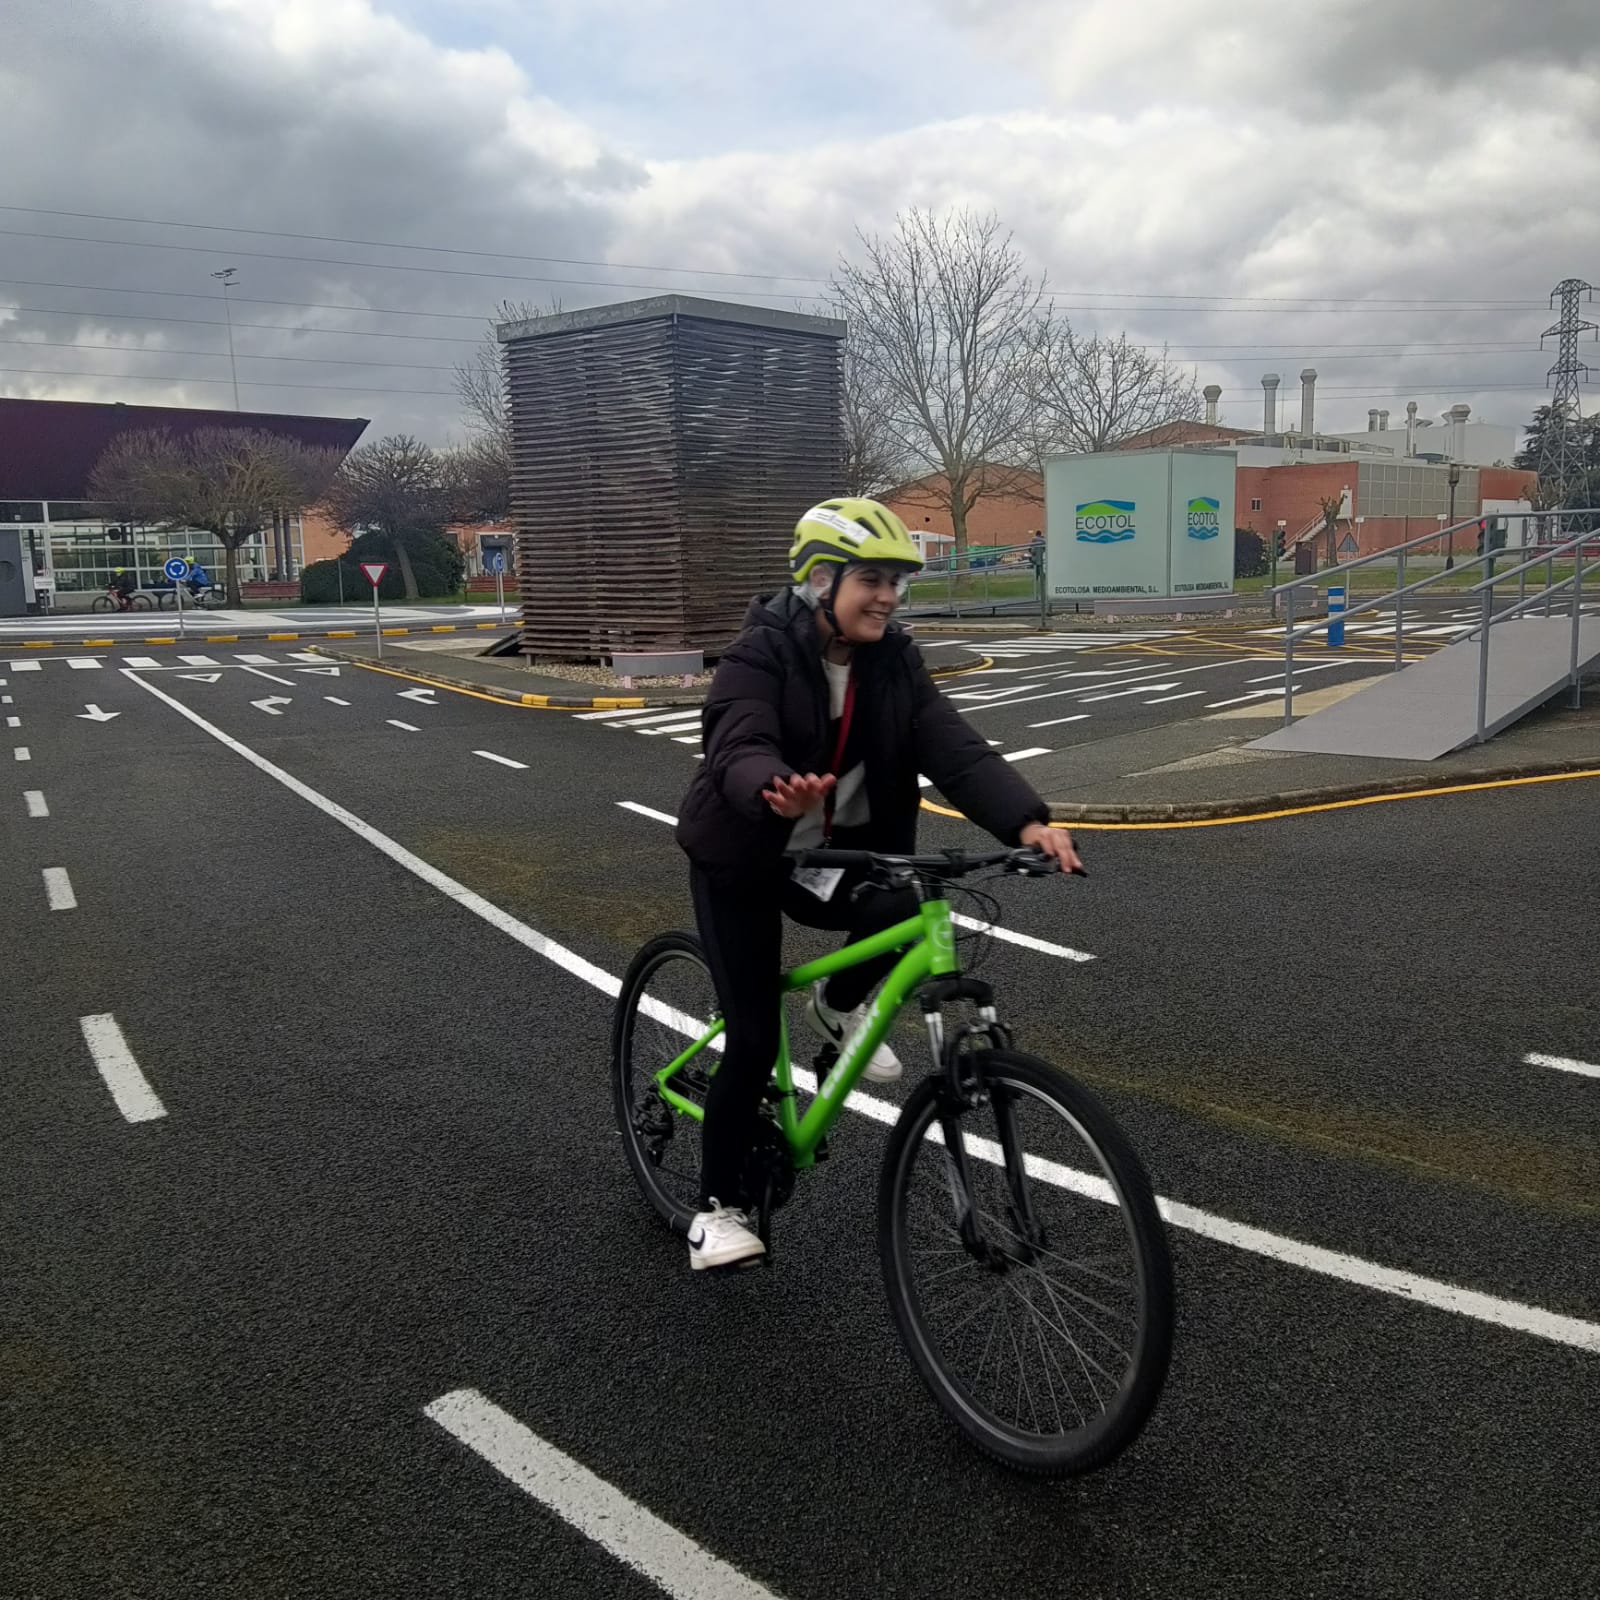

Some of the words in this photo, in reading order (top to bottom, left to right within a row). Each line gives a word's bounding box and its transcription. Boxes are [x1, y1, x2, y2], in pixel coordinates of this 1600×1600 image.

[1075, 515, 1136, 530] ECOTOL
[1187, 512, 1220, 526] ECOTOL
[1055, 586, 1090, 594] ECOTOLOSA
